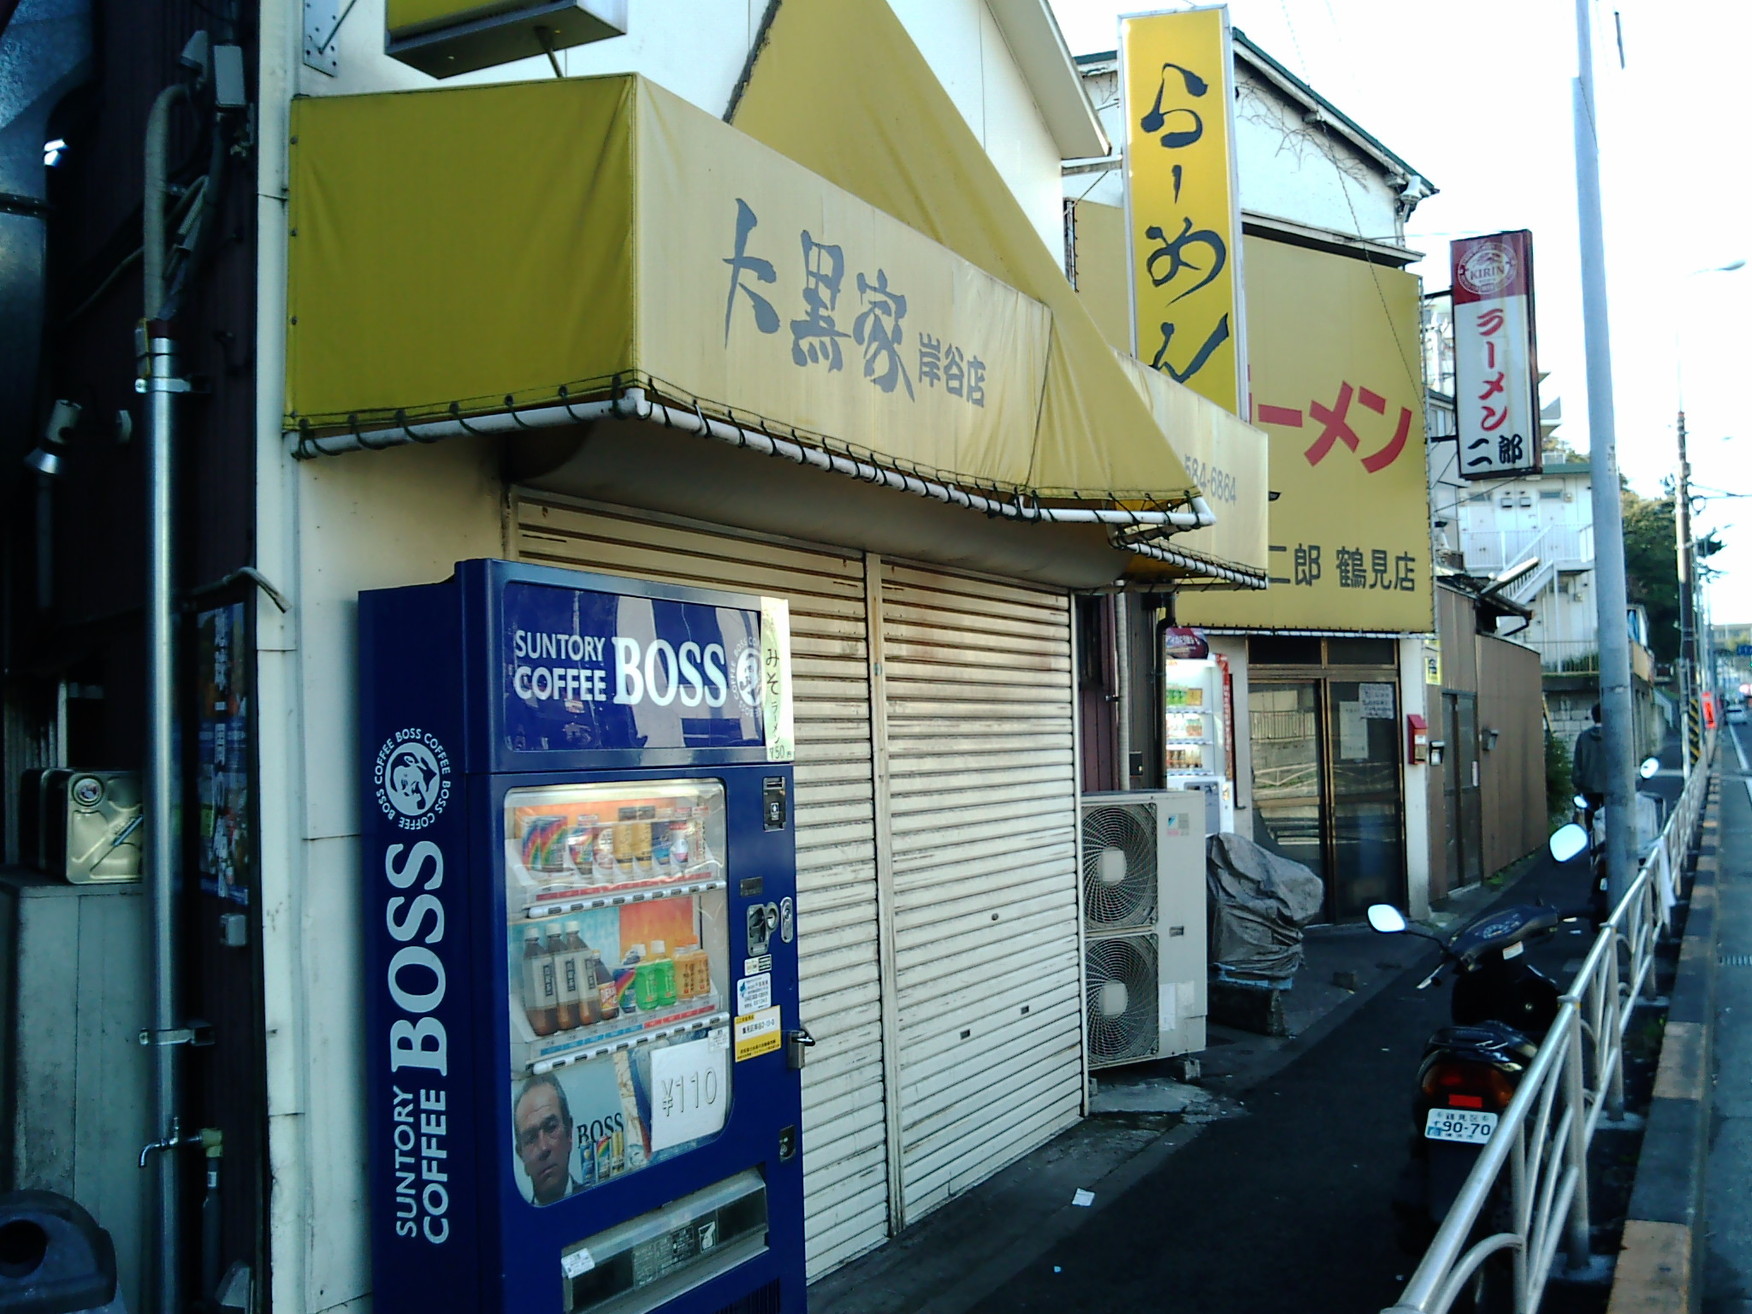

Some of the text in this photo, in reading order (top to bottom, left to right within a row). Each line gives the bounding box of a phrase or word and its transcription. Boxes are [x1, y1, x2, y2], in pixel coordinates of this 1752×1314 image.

[1140, 62, 1229, 383] らーめん
[1470, 265, 1505, 280] KIRIN
[918, 332, 987, 408] 岸谷店
[1476, 308, 1508, 431] ラーメン
[1467, 434, 1523, 467] 二郎
[1335, 546, 1416, 592] 鶴見店
[513, 636, 729, 708] COFFEE BOSS
[514, 629, 606, 662] SUNTORY
[374, 728, 451, 830] COFFEE BOSS COFFEE BOSS COFFEE BOSS
[385, 840, 448, 1077] BOSS
[393, 1085, 417, 1239] SUNTORY
[577, 1112, 624, 1149] BOSS
[1442, 1121, 1491, 1136] 90-70
[420, 1088, 449, 1245] COFFEE
